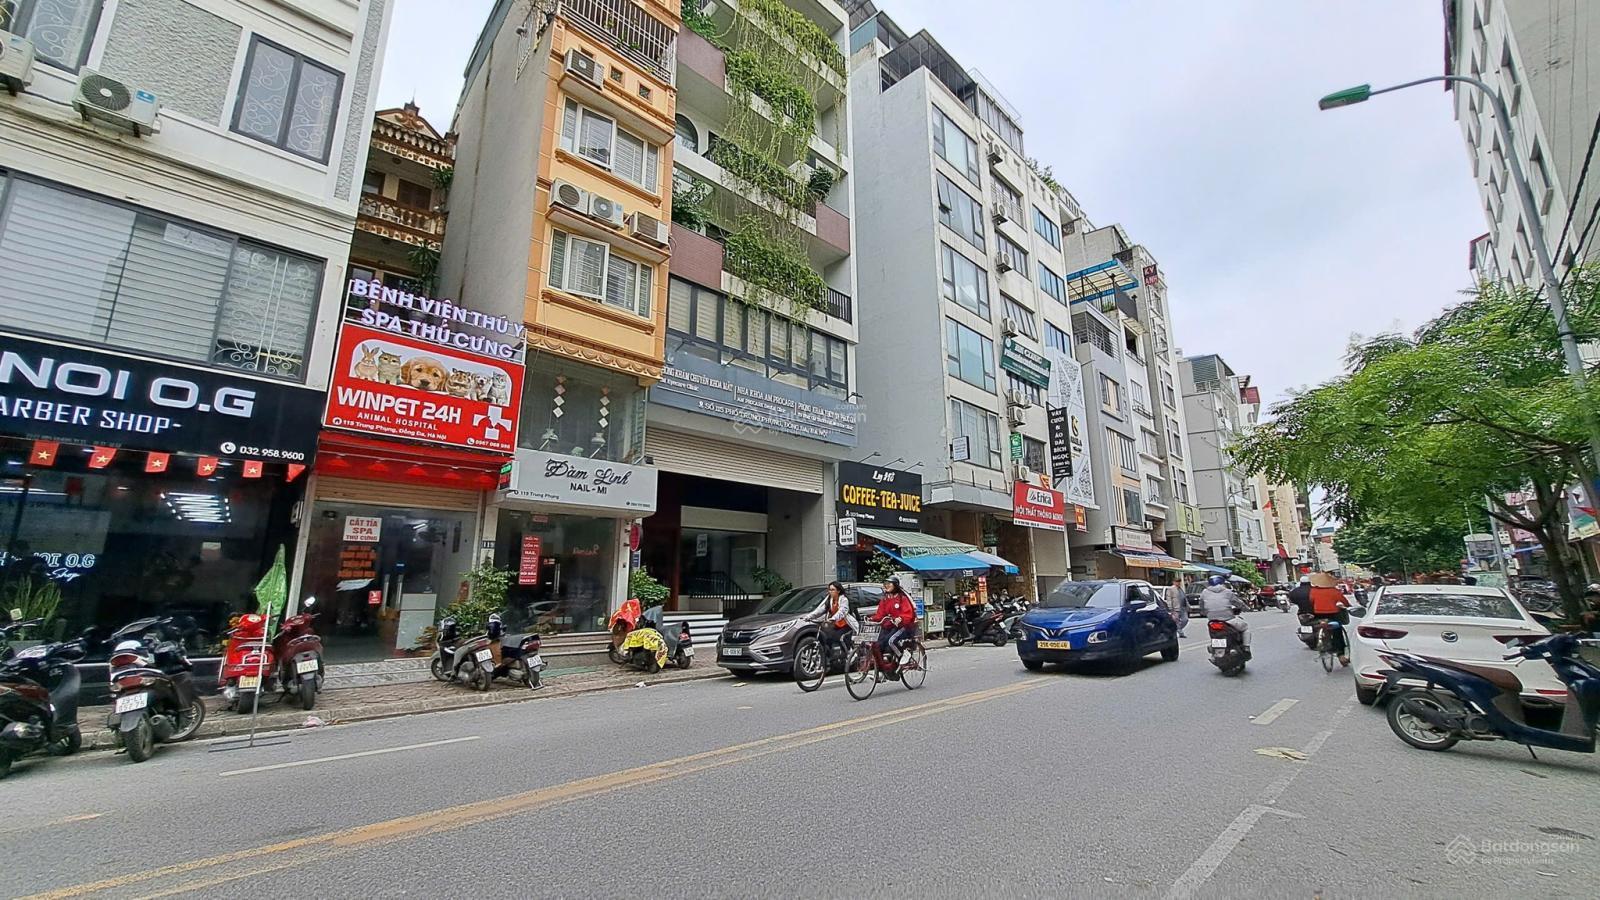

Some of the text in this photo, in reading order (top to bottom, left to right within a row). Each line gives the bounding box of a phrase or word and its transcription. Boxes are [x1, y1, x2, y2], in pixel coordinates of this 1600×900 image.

[353, 279, 525, 338] BỆNH VIỆN THÚ Y
[361, 309, 513, 358] SPA THÚ CƯNG
[150, 376, 256, 418] O.G
[337, 386, 462, 424] WINPET 24H
[357, 412, 438, 431] ANIMAL HOSPITAL
[240, 446, 305, 461] 032 958.9600
[593, 468, 632, 485] Linh
[570, 482, 591, 493] NAIL
[597, 484, 607, 494] MI
[1037, 491, 1052, 505] Erica
[841, 524, 852, 536] 115
